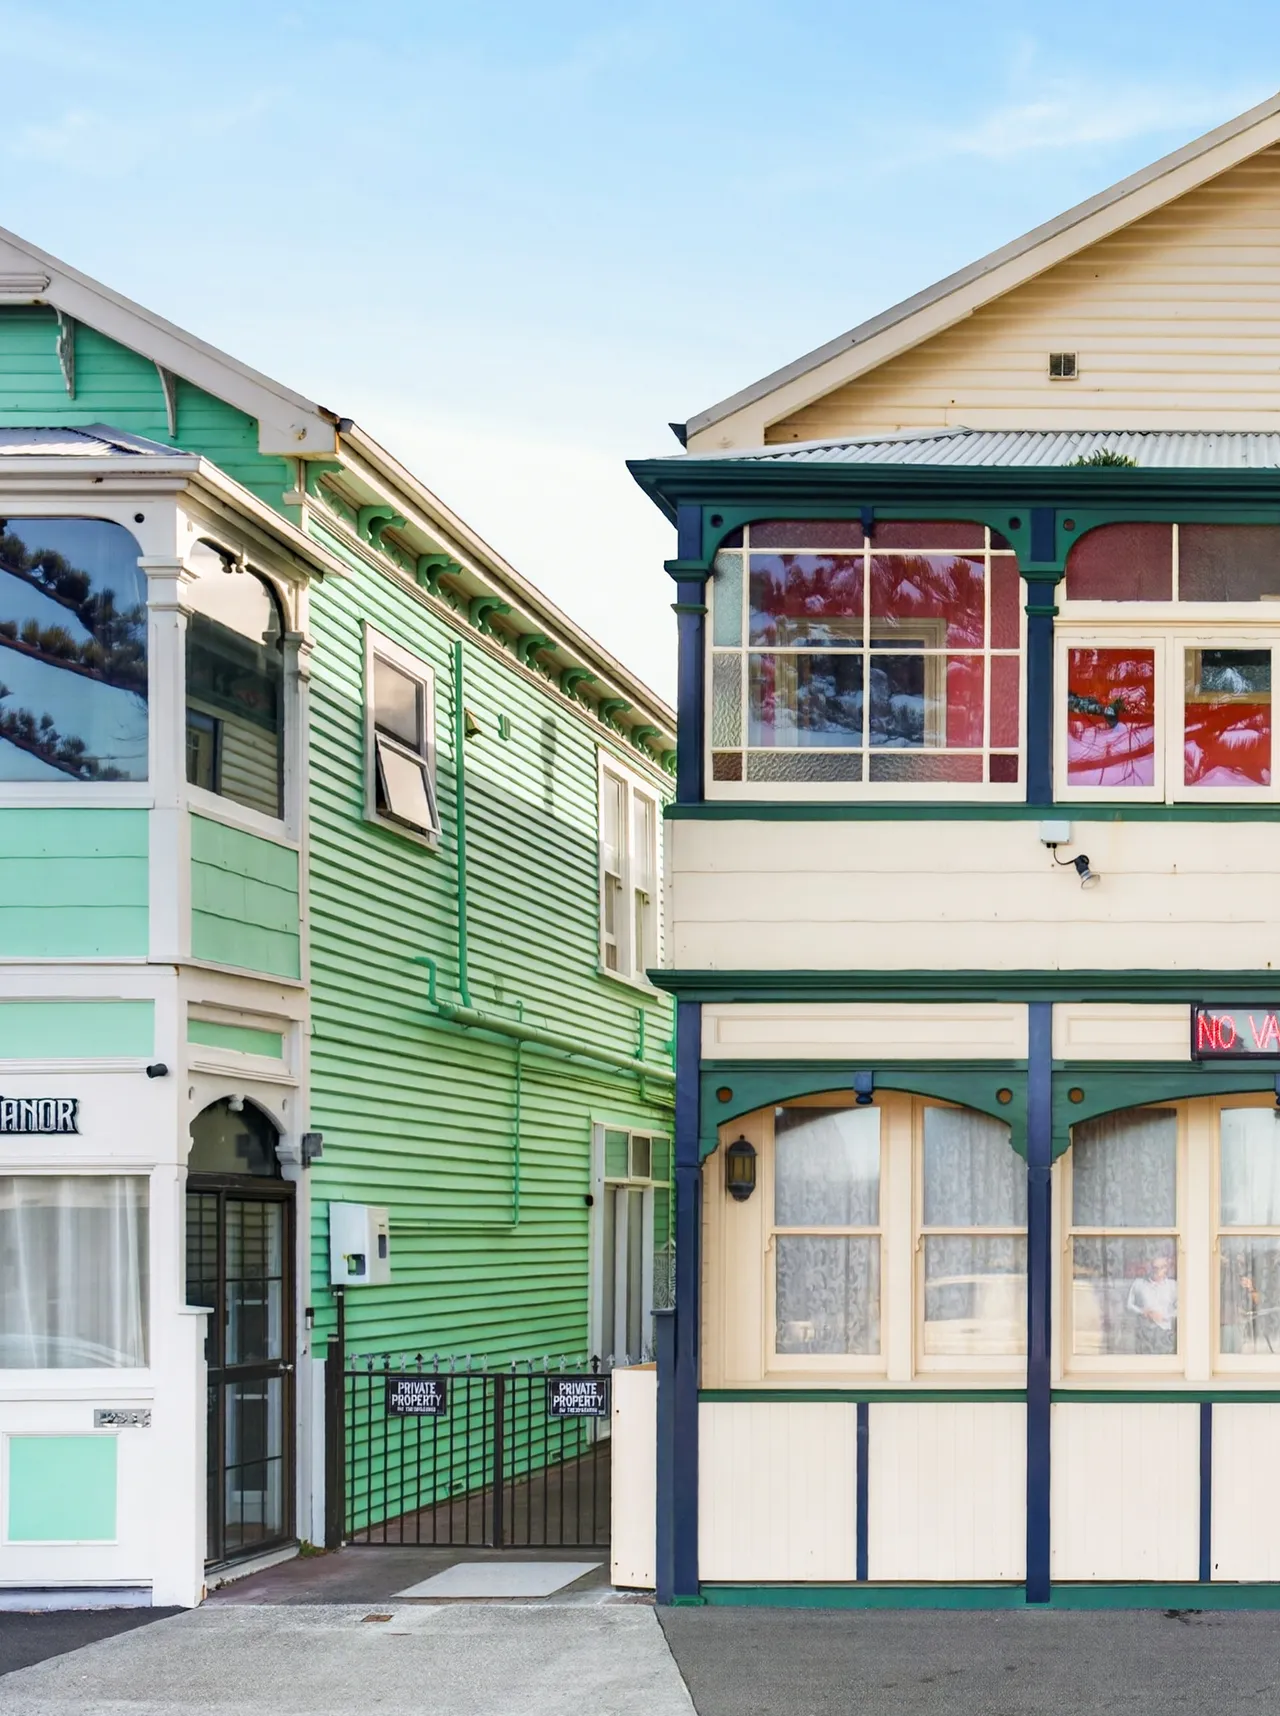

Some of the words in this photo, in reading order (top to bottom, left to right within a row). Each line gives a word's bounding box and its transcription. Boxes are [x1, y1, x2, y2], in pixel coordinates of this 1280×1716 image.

[1197, 1014, 1236, 1050] NO
[0, 1099, 75, 1132] ANOR
[397, 1381, 436, 1395] PRIVATE
[559, 1382, 598, 1395] PRIVATE
[391, 1394, 442, 1406] PROPERTY
[553, 1395, 603, 1407] PROPERTY
